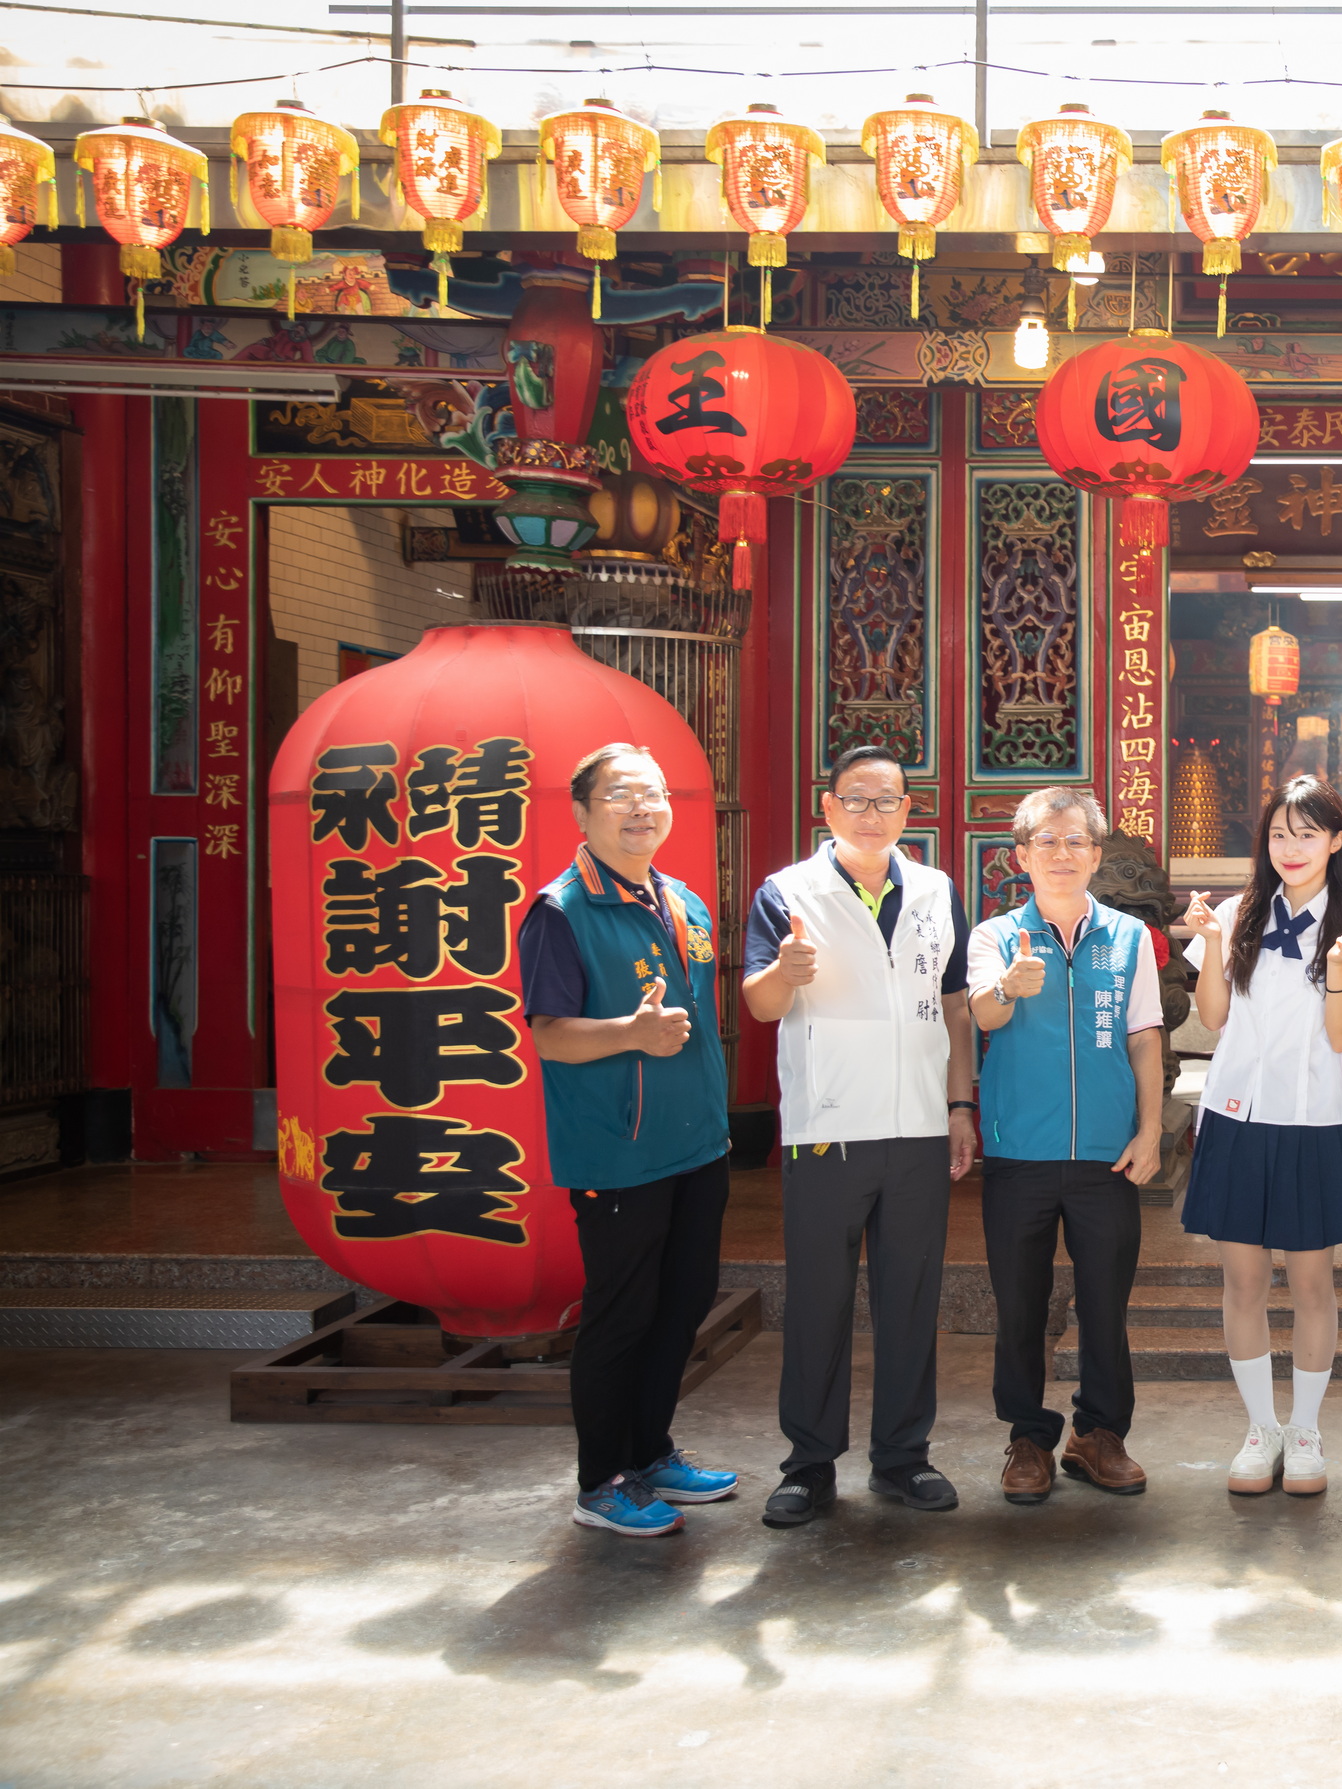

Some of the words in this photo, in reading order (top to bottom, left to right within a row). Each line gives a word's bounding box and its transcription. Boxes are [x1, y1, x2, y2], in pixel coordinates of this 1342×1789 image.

[655, 350, 747, 437] 王
[1094, 357, 1188, 452] 國
[311, 736, 535, 852] 永靖
[1113, 975, 1126, 1019] 理事長
[319, 853, 531, 1247] 謝平安
[776, 1485, 810, 1496] PUMA
[912, 1472, 944, 1484] PUMA
